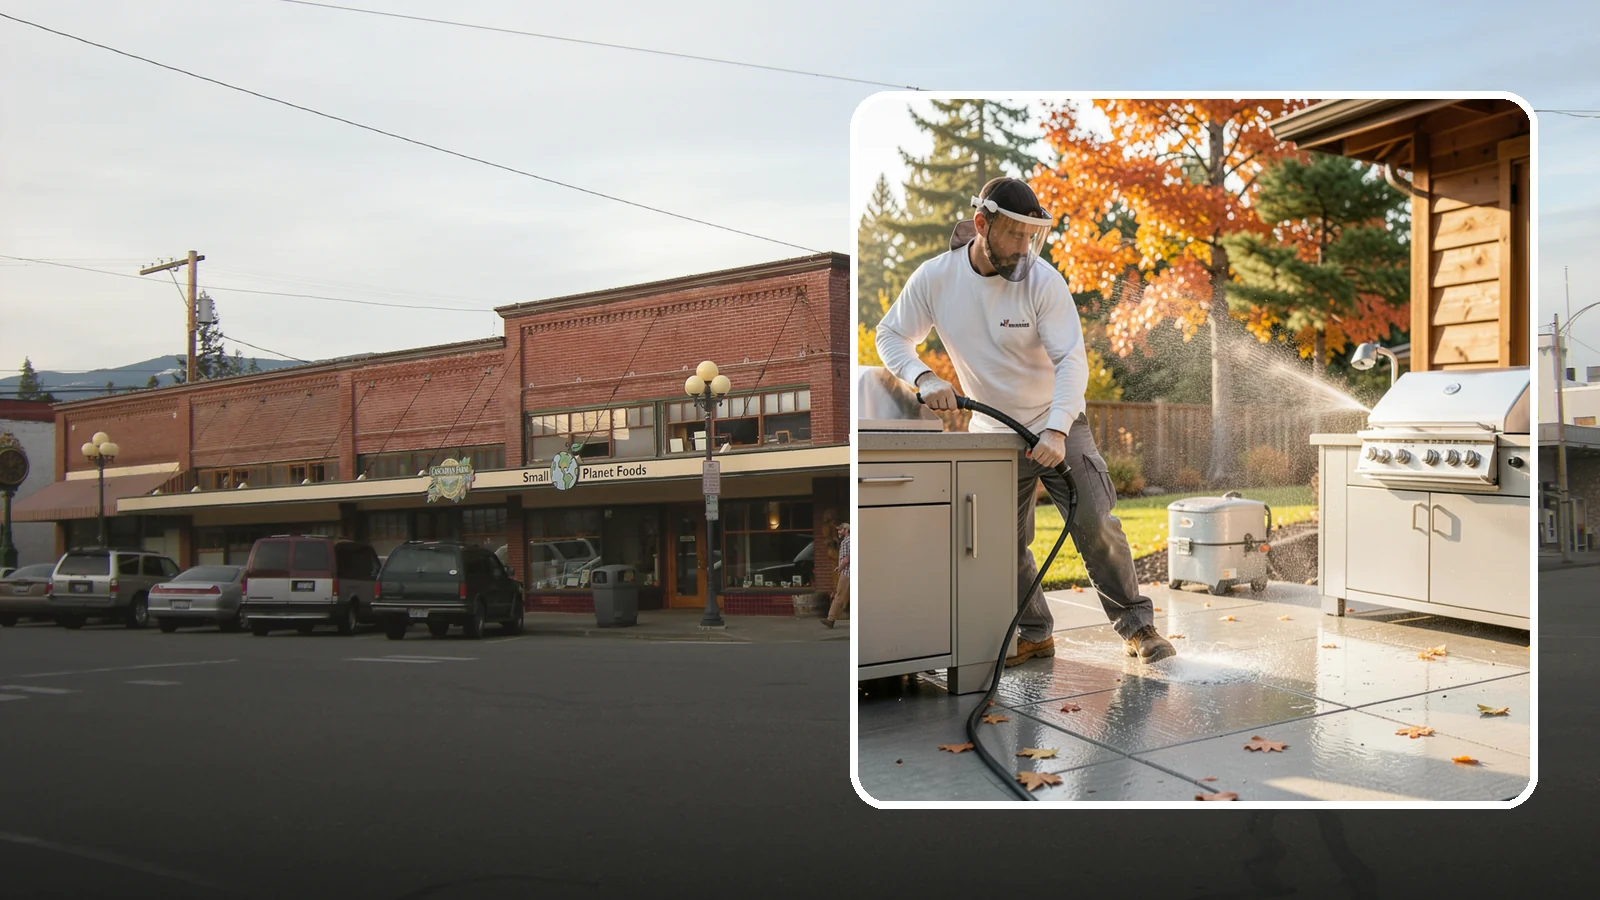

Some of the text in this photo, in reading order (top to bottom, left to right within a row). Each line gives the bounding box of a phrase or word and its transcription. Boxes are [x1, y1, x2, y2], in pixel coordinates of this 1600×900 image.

[523, 464, 647, 483] Small Planet Foods
